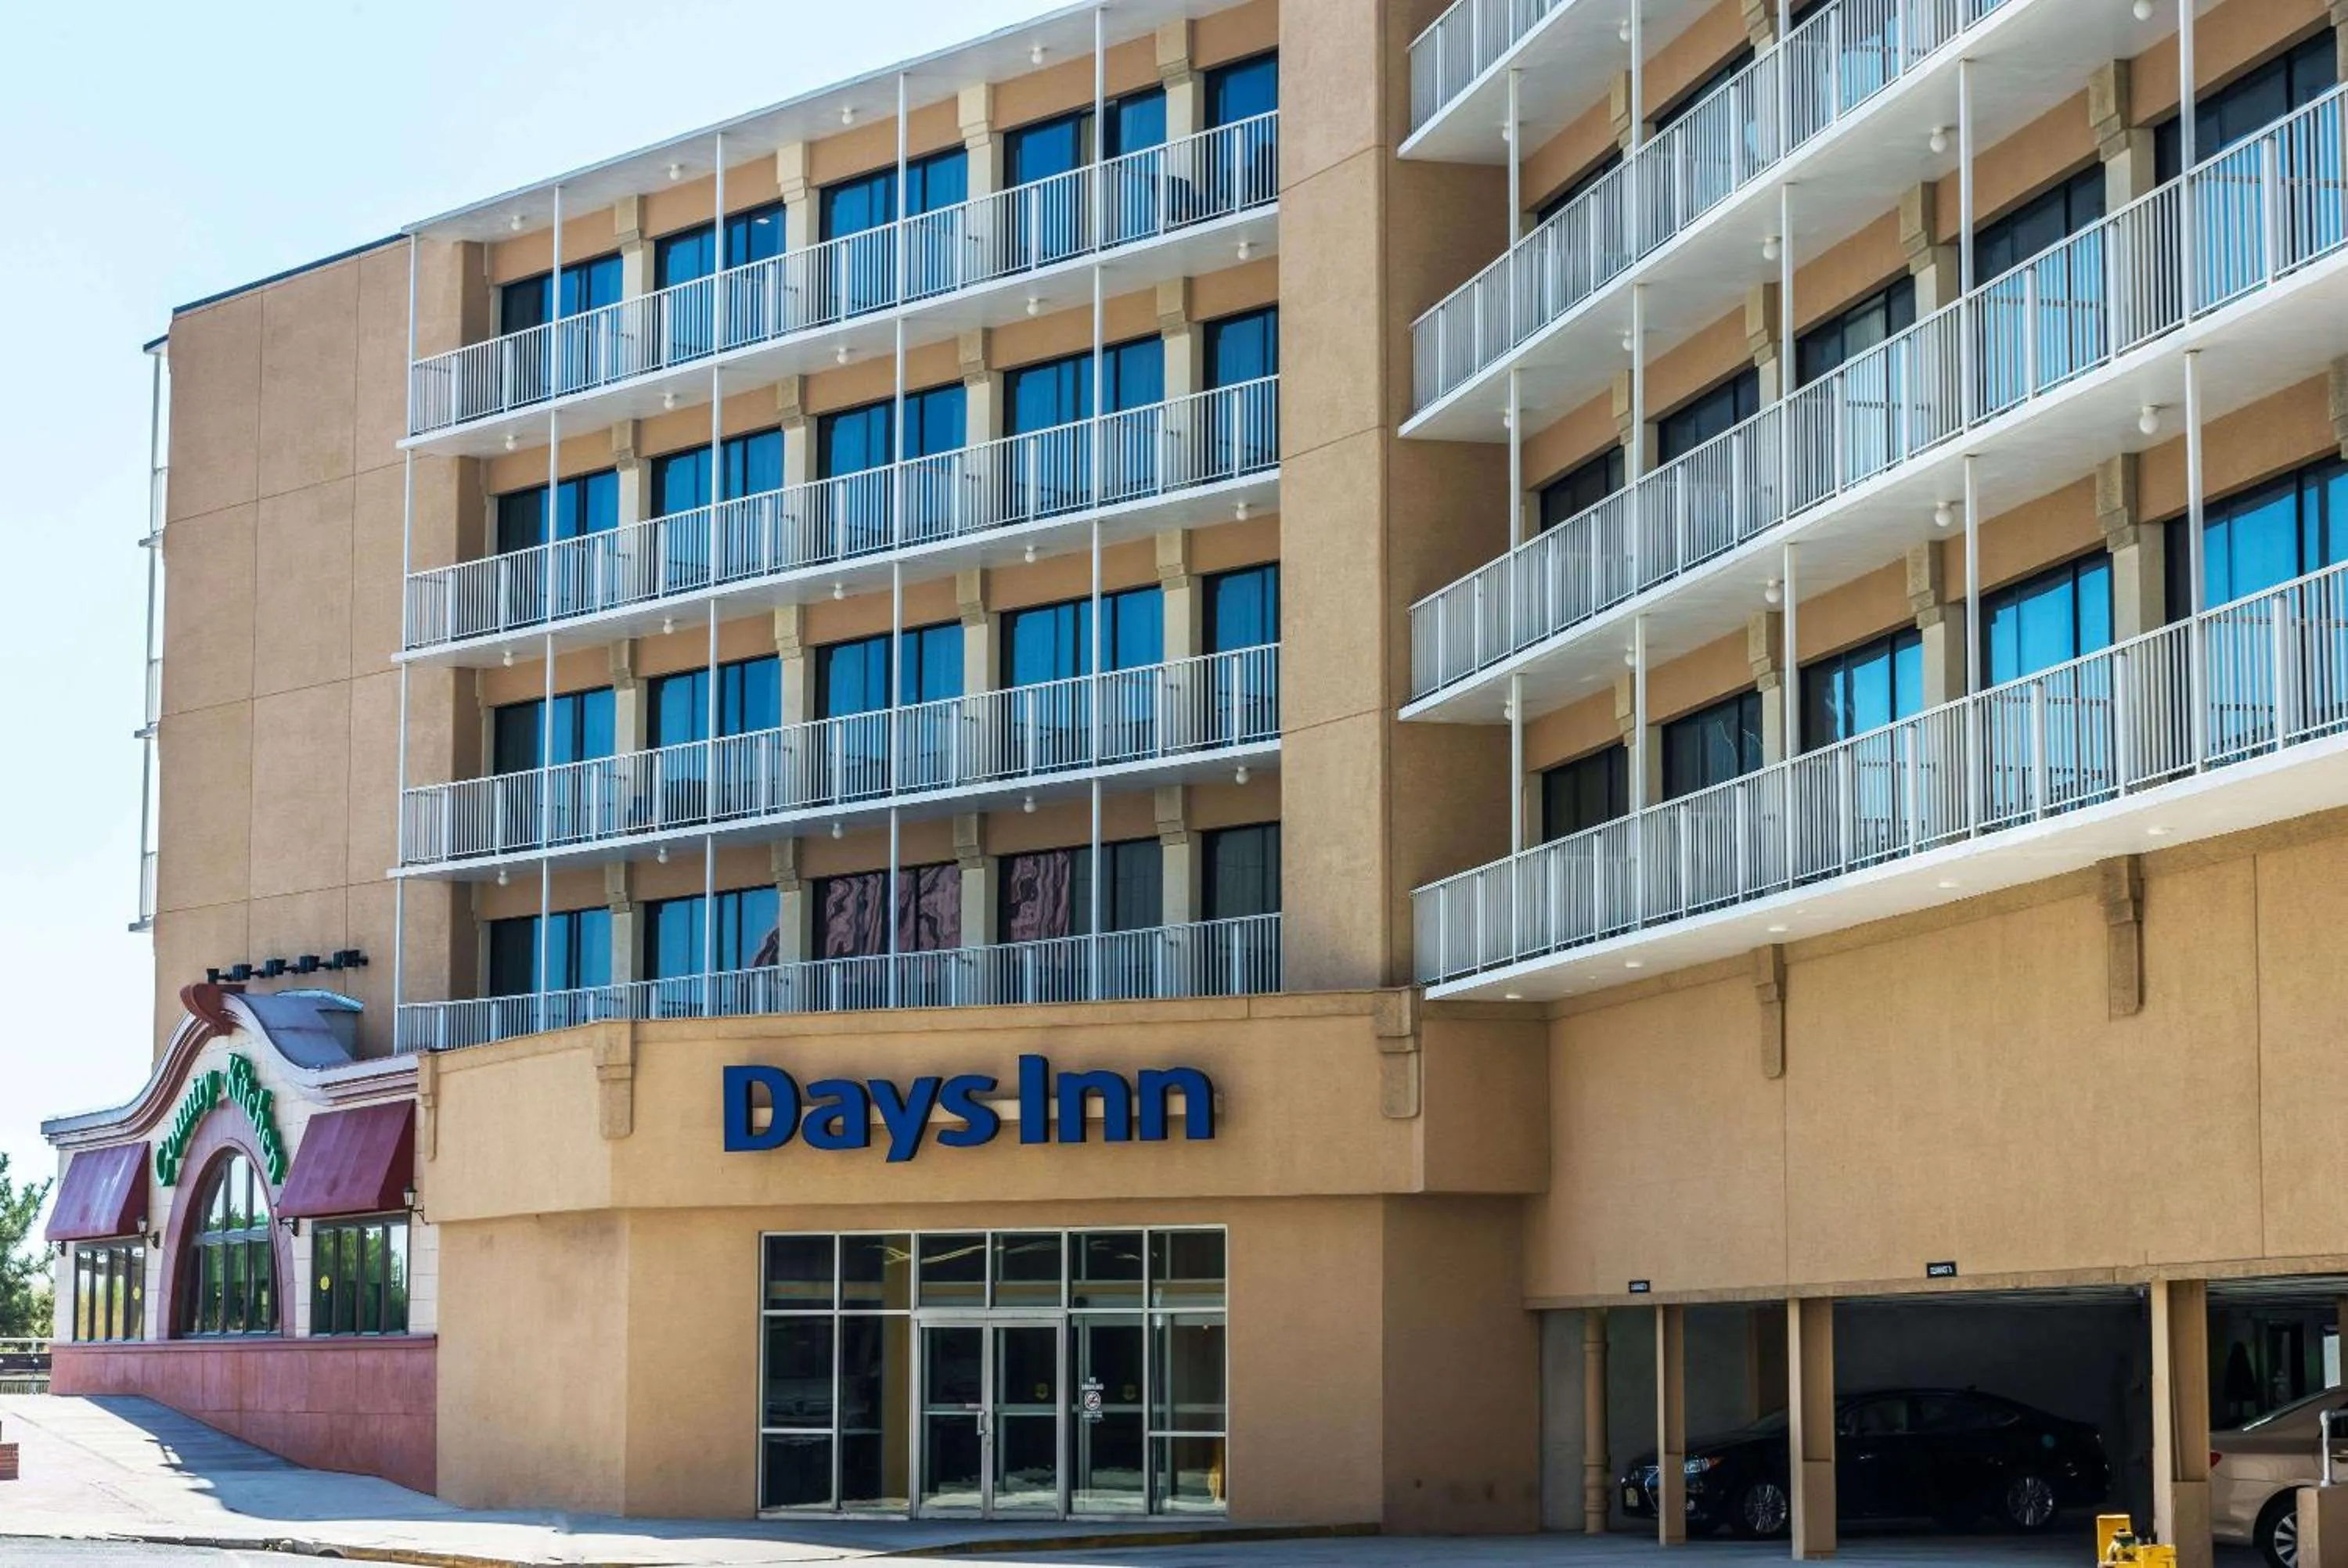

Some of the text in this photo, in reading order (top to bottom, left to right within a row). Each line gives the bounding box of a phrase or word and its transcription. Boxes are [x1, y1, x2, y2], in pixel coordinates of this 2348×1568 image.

[157, 1052, 285, 1186] Country Kitchen
[723, 1054, 1215, 1163] Days Inn
